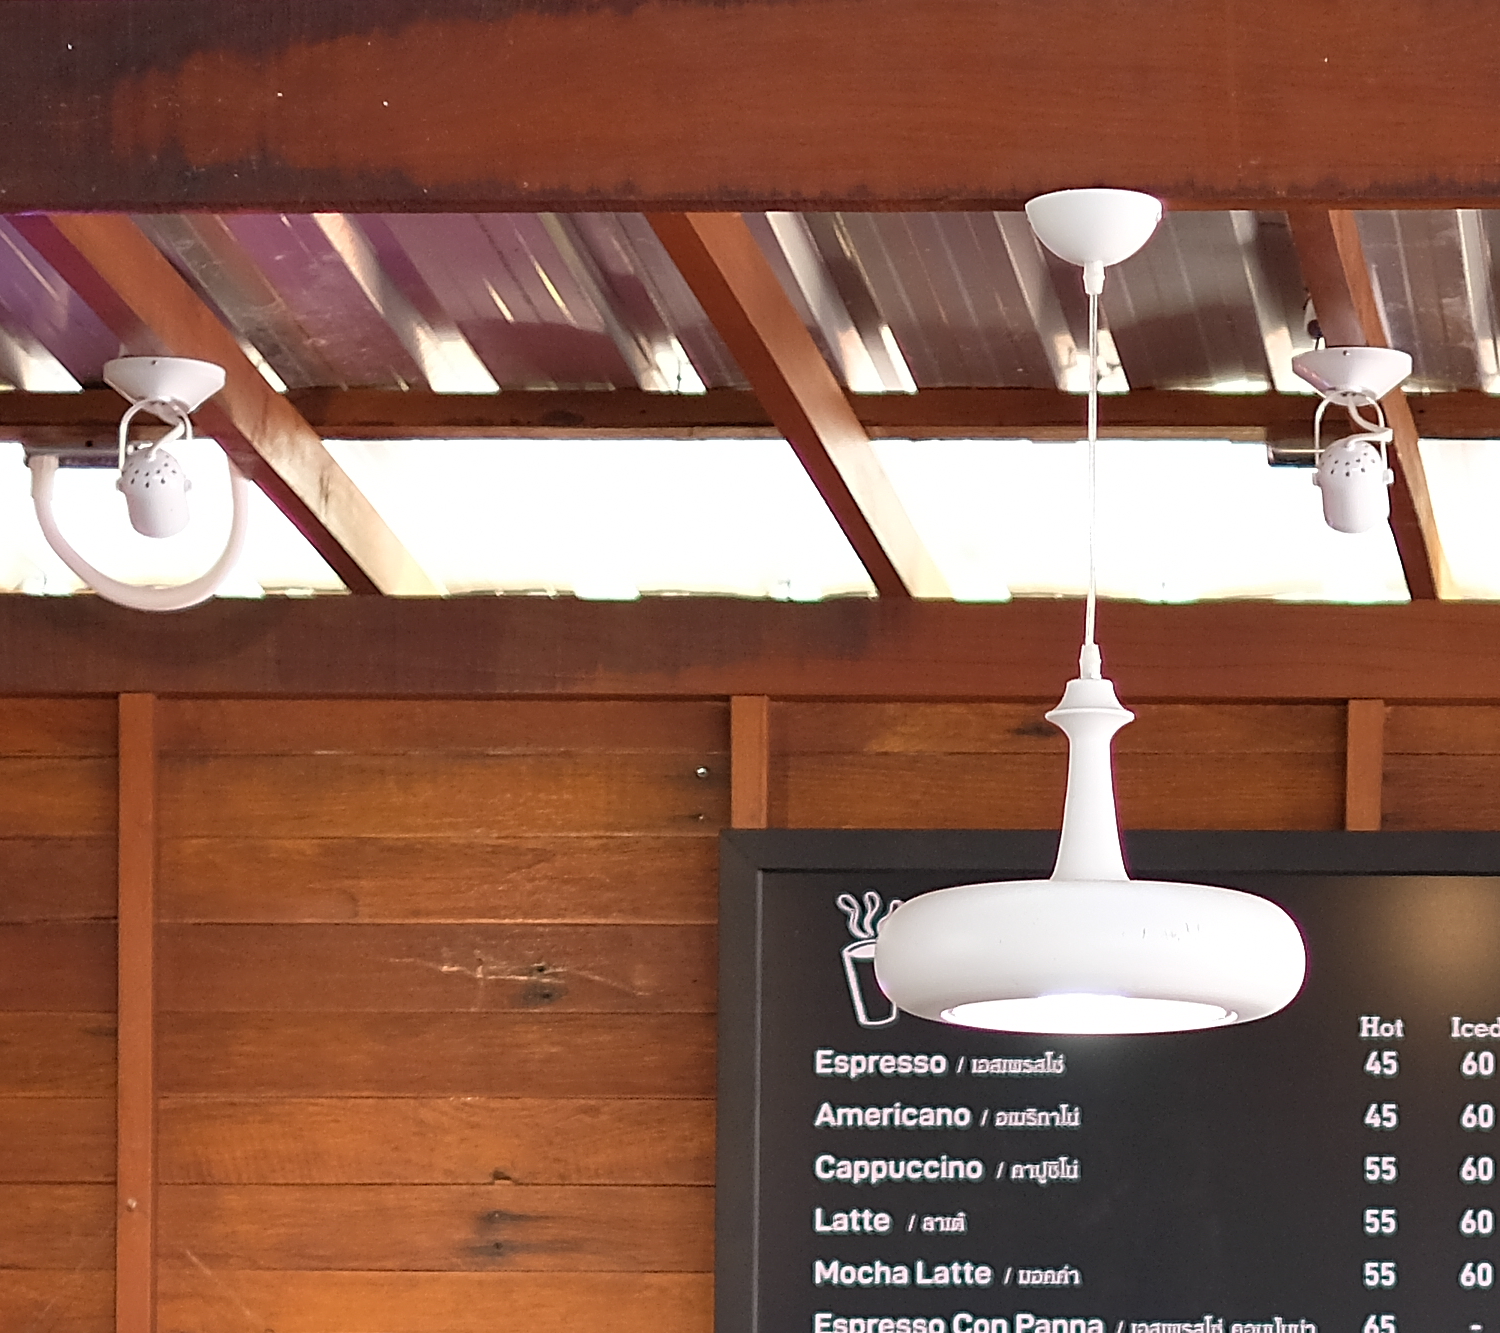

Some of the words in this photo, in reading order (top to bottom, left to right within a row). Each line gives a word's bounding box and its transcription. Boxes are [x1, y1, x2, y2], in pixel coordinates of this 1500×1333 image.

[1359, 1016, 1404, 1038] Hot
[815, 1049, 947, 1079] Espresso
[1365, 1050, 1398, 1076] 45
[1462, 1051, 1495, 1076] 60
[813, 1102, 971, 1127] Americano
[1364, 1103, 1397, 1128] 45
[1461, 1103, 1494, 1129] 60
[815, 1154, 983, 1185] Cappuccino
[1365, 1156, 1397, 1181] 55
[1461, 1156, 1494, 1182] 60
[814, 1207, 891, 1233] Latte
[1365, 1209, 1396, 1234] 55
[1460, 1209, 1493, 1235] 60
[814, 1259, 909, 1285] Mocha
[916, 1260, 992, 1285] Latte
[1364, 1262, 1396, 1287] 55
[1460, 1262, 1493, 1287] 60
